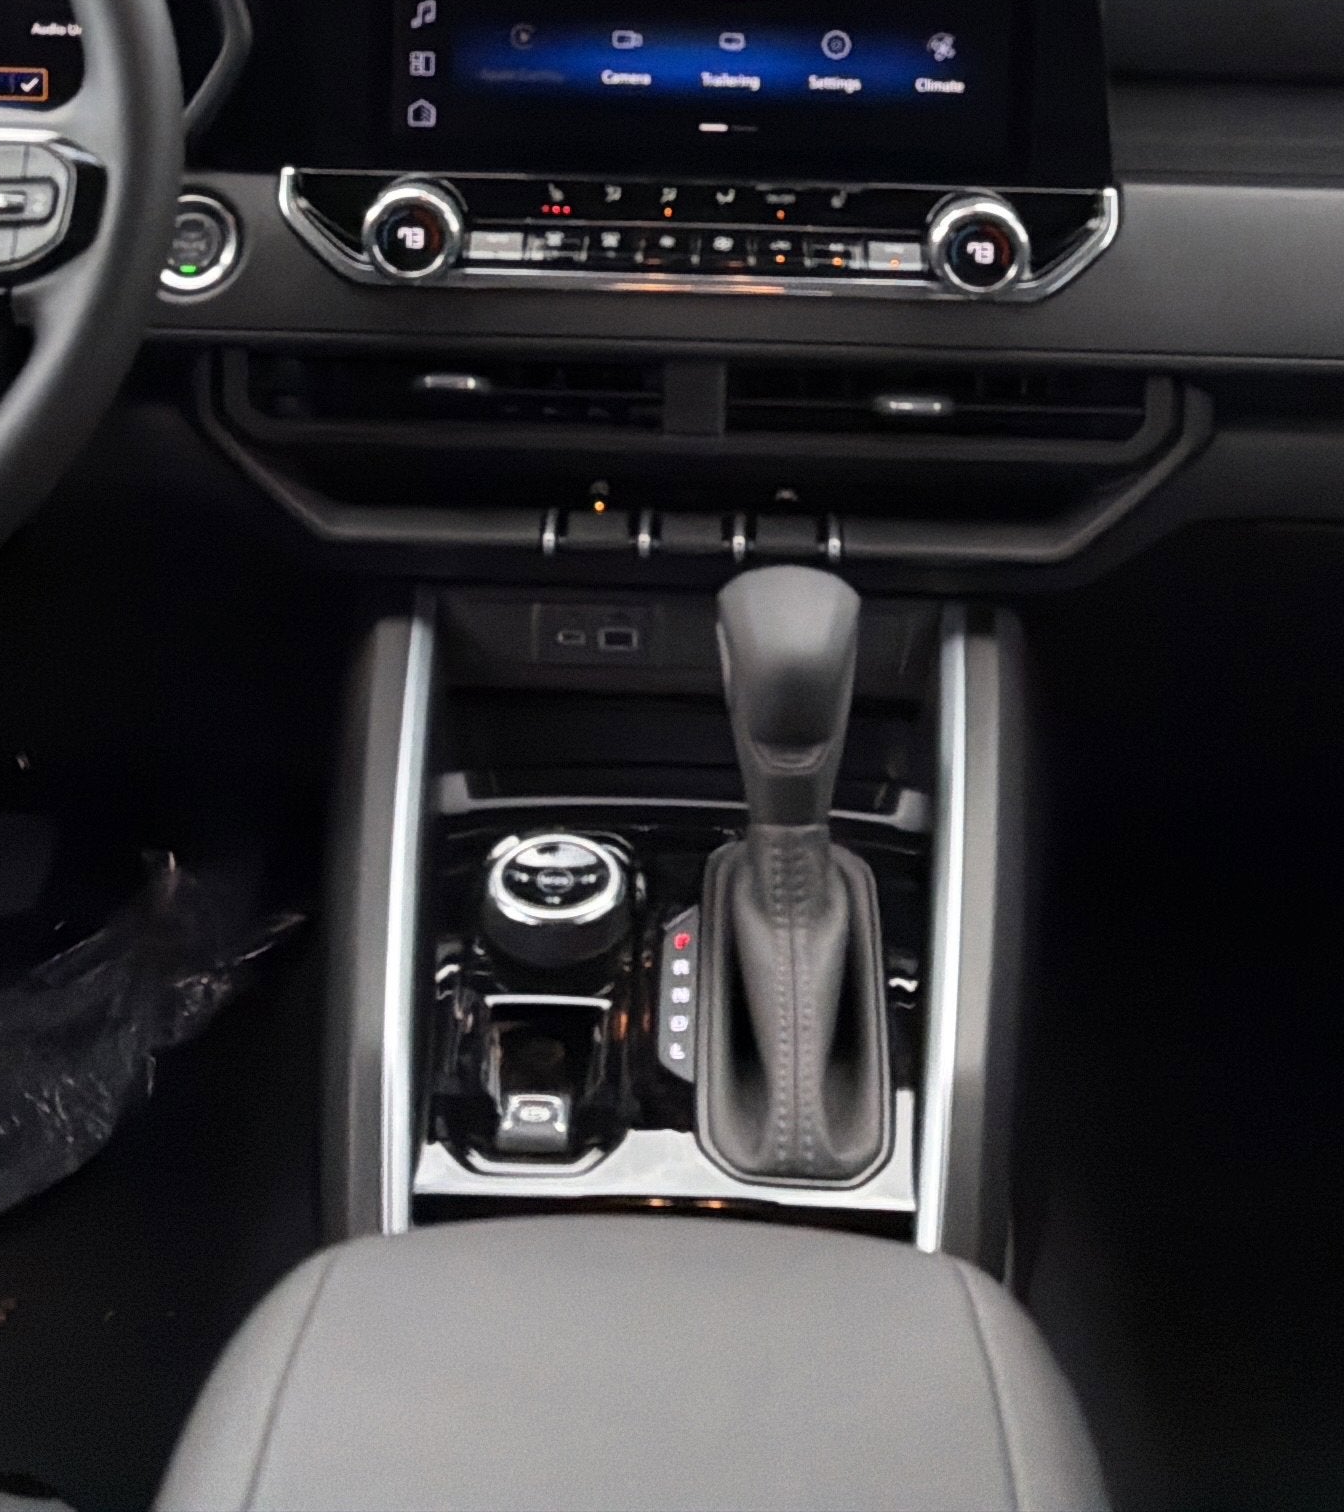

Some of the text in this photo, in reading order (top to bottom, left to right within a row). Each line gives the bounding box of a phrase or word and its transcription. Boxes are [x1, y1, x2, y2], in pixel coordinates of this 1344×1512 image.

[601, 69, 652, 86] Camera
[809, 74, 862, 94] Settings
[915, 77, 965, 94] Climate
[670, 1015, 688, 1032] D
[670, 1043, 685, 1059] L
